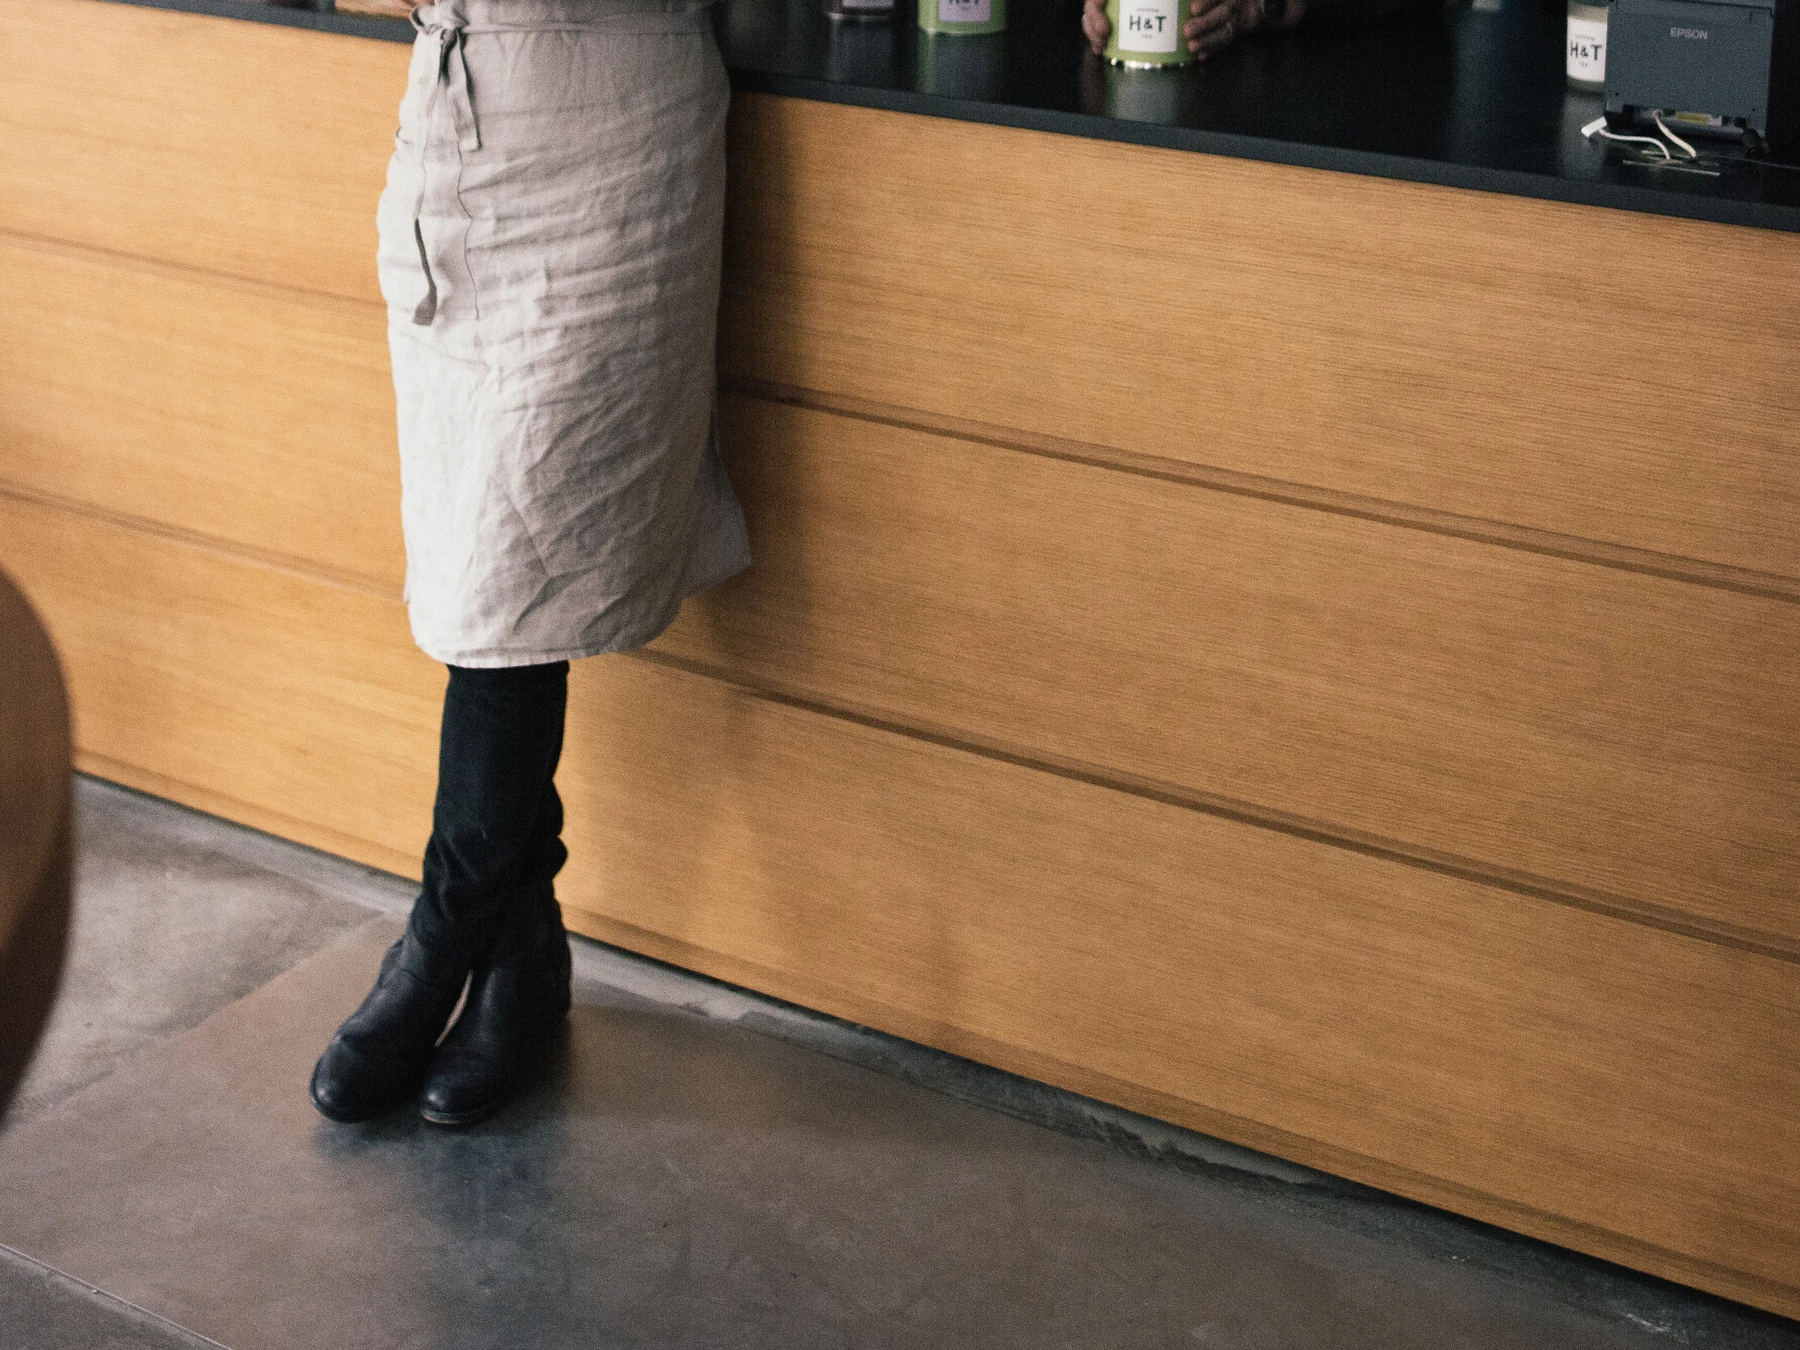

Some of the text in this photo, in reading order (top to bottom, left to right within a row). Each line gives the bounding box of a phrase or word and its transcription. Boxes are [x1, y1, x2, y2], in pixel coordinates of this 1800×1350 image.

[1129, 14, 1167, 32] H&T
[1670, 27, 1708, 40] EPSON
[1570, 41, 1602, 61] H&T
